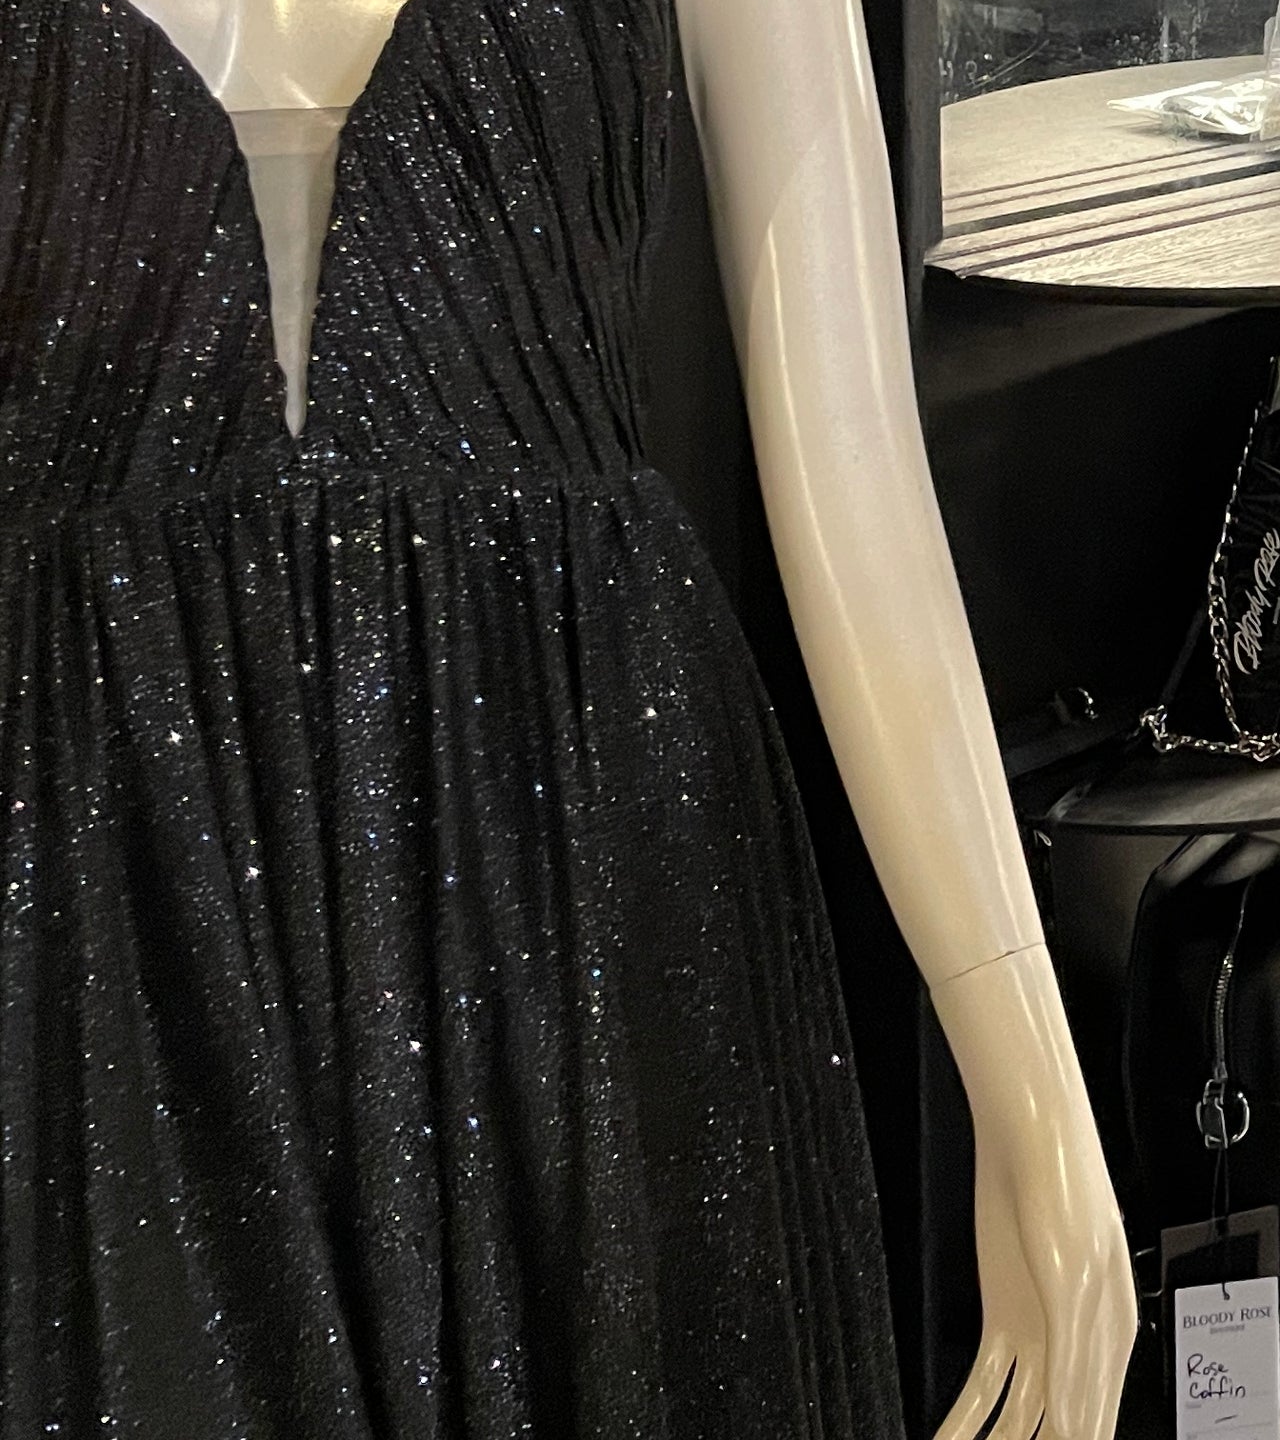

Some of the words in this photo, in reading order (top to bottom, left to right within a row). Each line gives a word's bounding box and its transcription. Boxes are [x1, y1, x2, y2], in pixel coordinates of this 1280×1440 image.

[1183, 1311, 1236, 1329] BLOODY
[1187, 1353, 1228, 1377] Rose
[1189, 1375, 1246, 1399] Coffin
